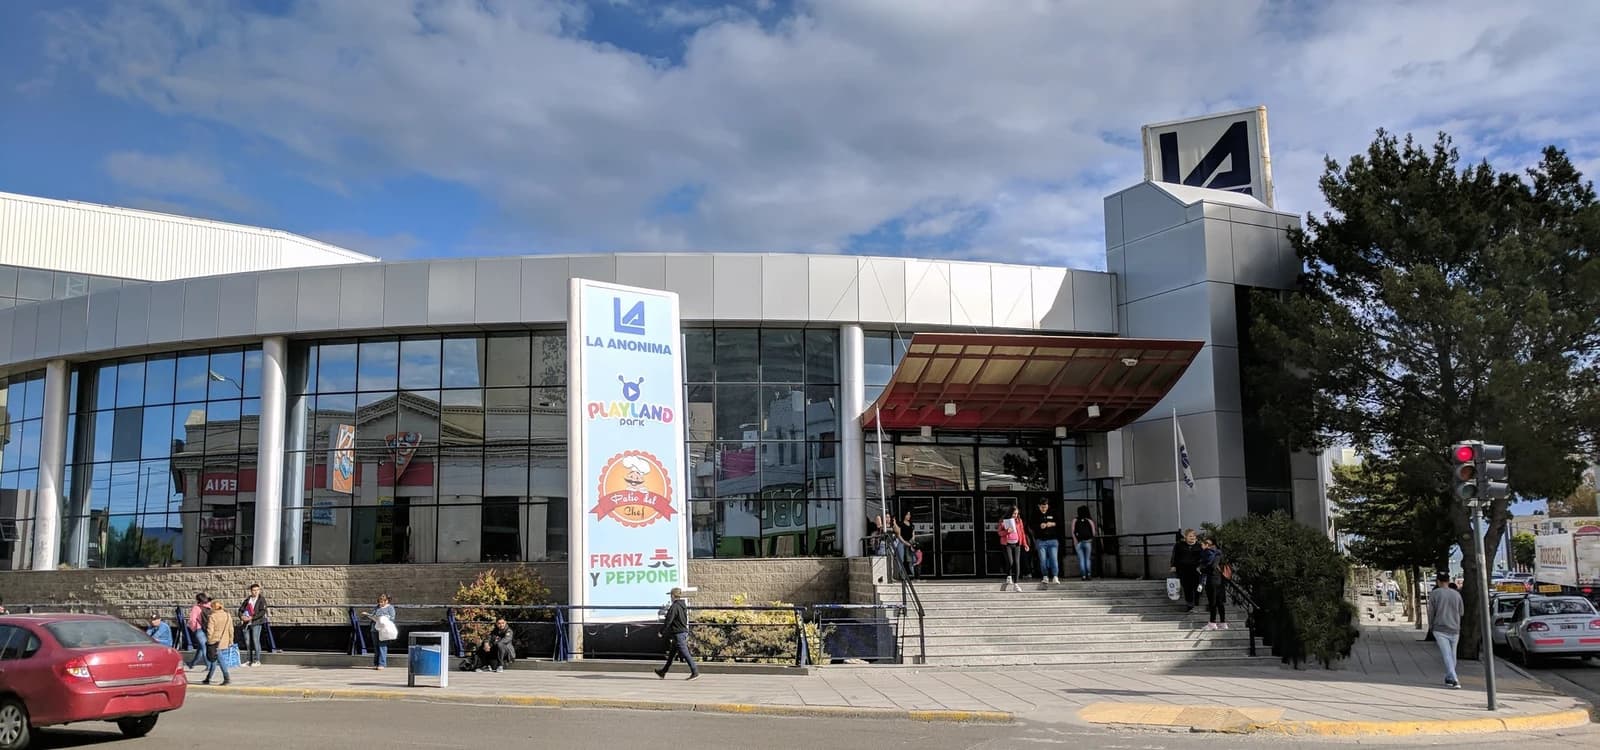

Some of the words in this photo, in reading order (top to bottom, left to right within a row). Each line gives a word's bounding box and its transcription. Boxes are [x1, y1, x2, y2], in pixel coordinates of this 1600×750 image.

[613, 297, 646, 336] LA
[586, 336, 604, 348] LA
[607, 338, 672, 355] ANONIMA
[587, 401, 674, 424] PLAYLAND
[610, 492, 639, 505] Patio
[643, 492, 658, 505] del
[624, 506, 646, 520] Chef
[590, 553, 644, 569] FRANZ
[590, 572, 600, 587] Y
[605, 569, 678, 585] PEPPONE
